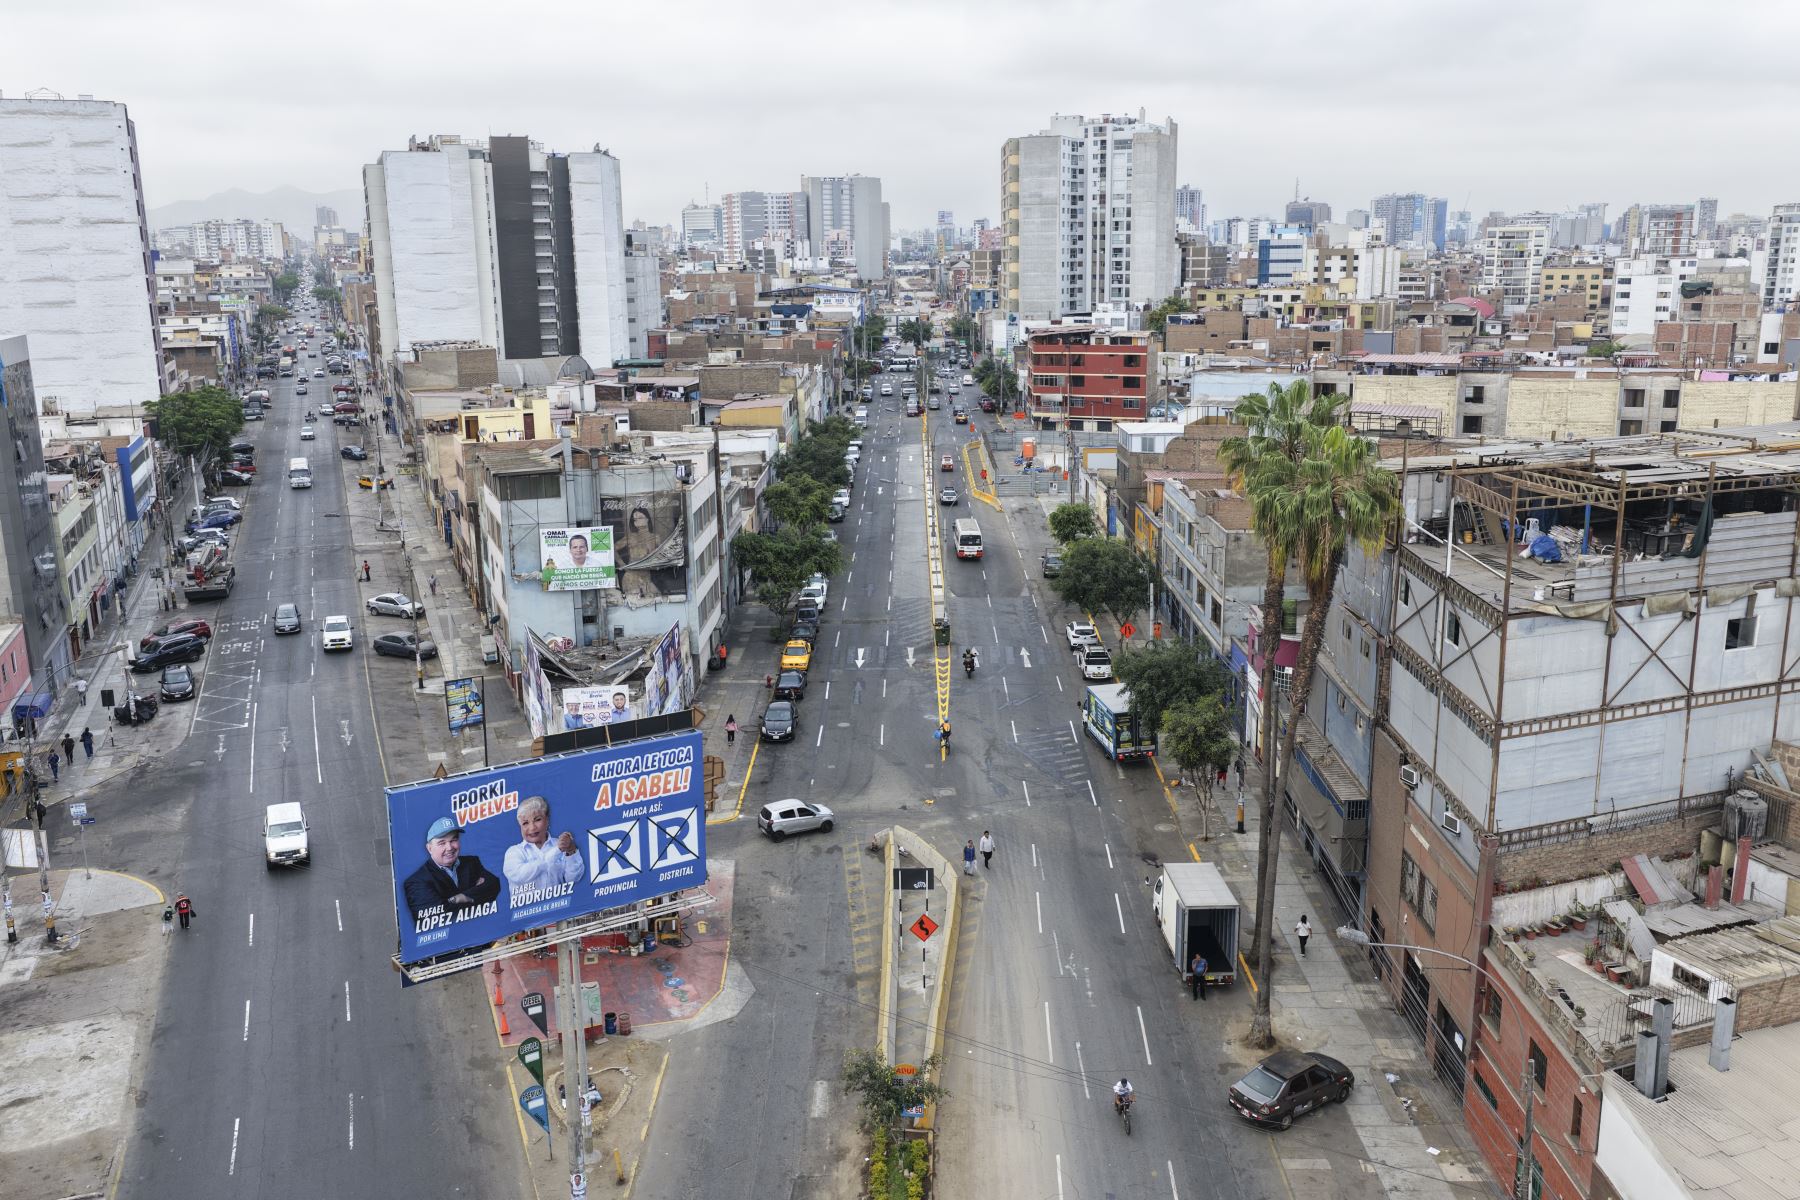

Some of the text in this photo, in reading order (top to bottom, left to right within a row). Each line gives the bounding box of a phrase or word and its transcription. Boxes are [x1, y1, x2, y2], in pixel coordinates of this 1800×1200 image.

[592, 746, 693, 782] ¡AHORA LE TOCA
[452, 779, 505, 812] ¡PORKI
[594, 766, 692, 811] A ISABEL!
[456, 791, 518, 827] VUELVE!
[622, 800, 663, 819] MARCA ASÍ:
[597, 817, 690, 876] R R
[659, 866, 694, 882] DISTRITAL
[512, 881, 536, 895] ISABEL
[594, 879, 638, 898] PROVINCIAL
[415, 900, 498, 934] LÓPEZ ALIAGA
[417, 904, 445, 919] RAFAEL
[513, 906, 542, 919] ALCALDESA
[419, 930, 447, 943] POR LIMA
[523, 995, 541, 1007] DIESEL
[521, 1088, 544, 1103] PREMIUM
